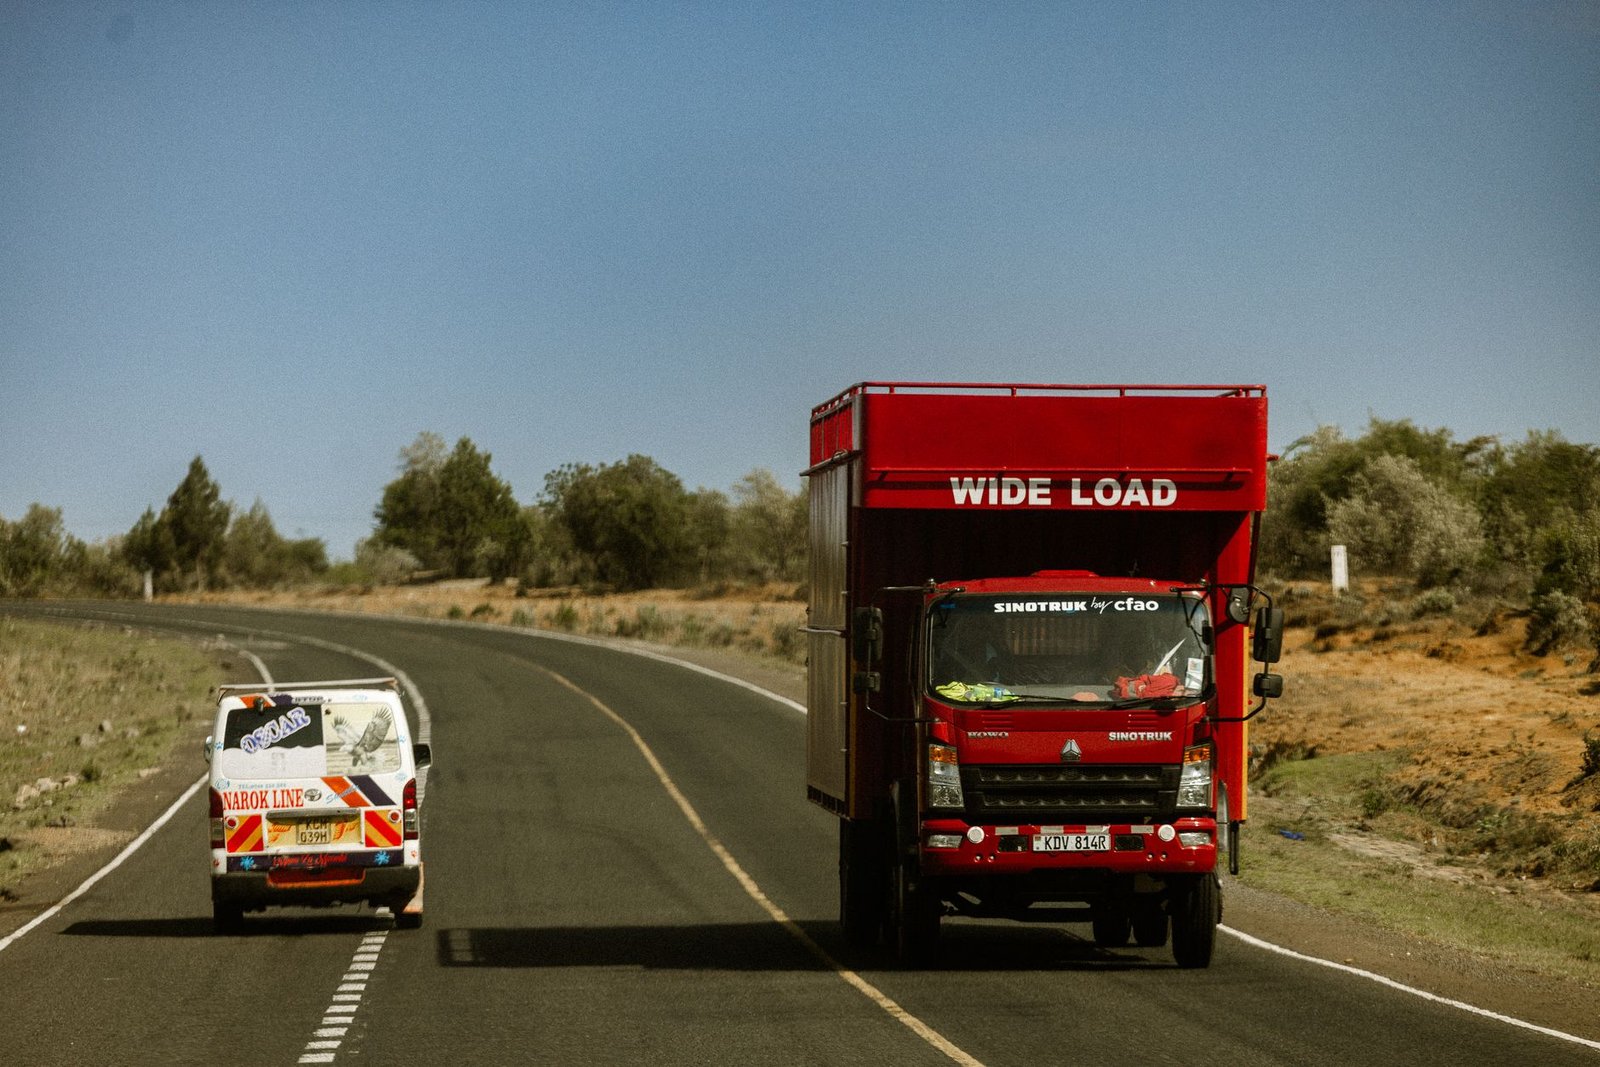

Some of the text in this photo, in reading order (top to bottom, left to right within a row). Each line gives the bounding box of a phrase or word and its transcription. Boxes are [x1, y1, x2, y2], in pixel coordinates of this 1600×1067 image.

[950, 477, 1178, 507] WIDE LOAD
[994, 596, 1159, 614] SINOTRUK by cfao
[241, 707, 311, 754] OSCAR
[1108, 731, 1172, 742] SINOTRUK
[223, 789, 269, 810] NAROK
[273, 788, 304, 809] LINE
[306, 817, 329, 830] KCM
[1044, 835, 1107, 850] KDV 814R
